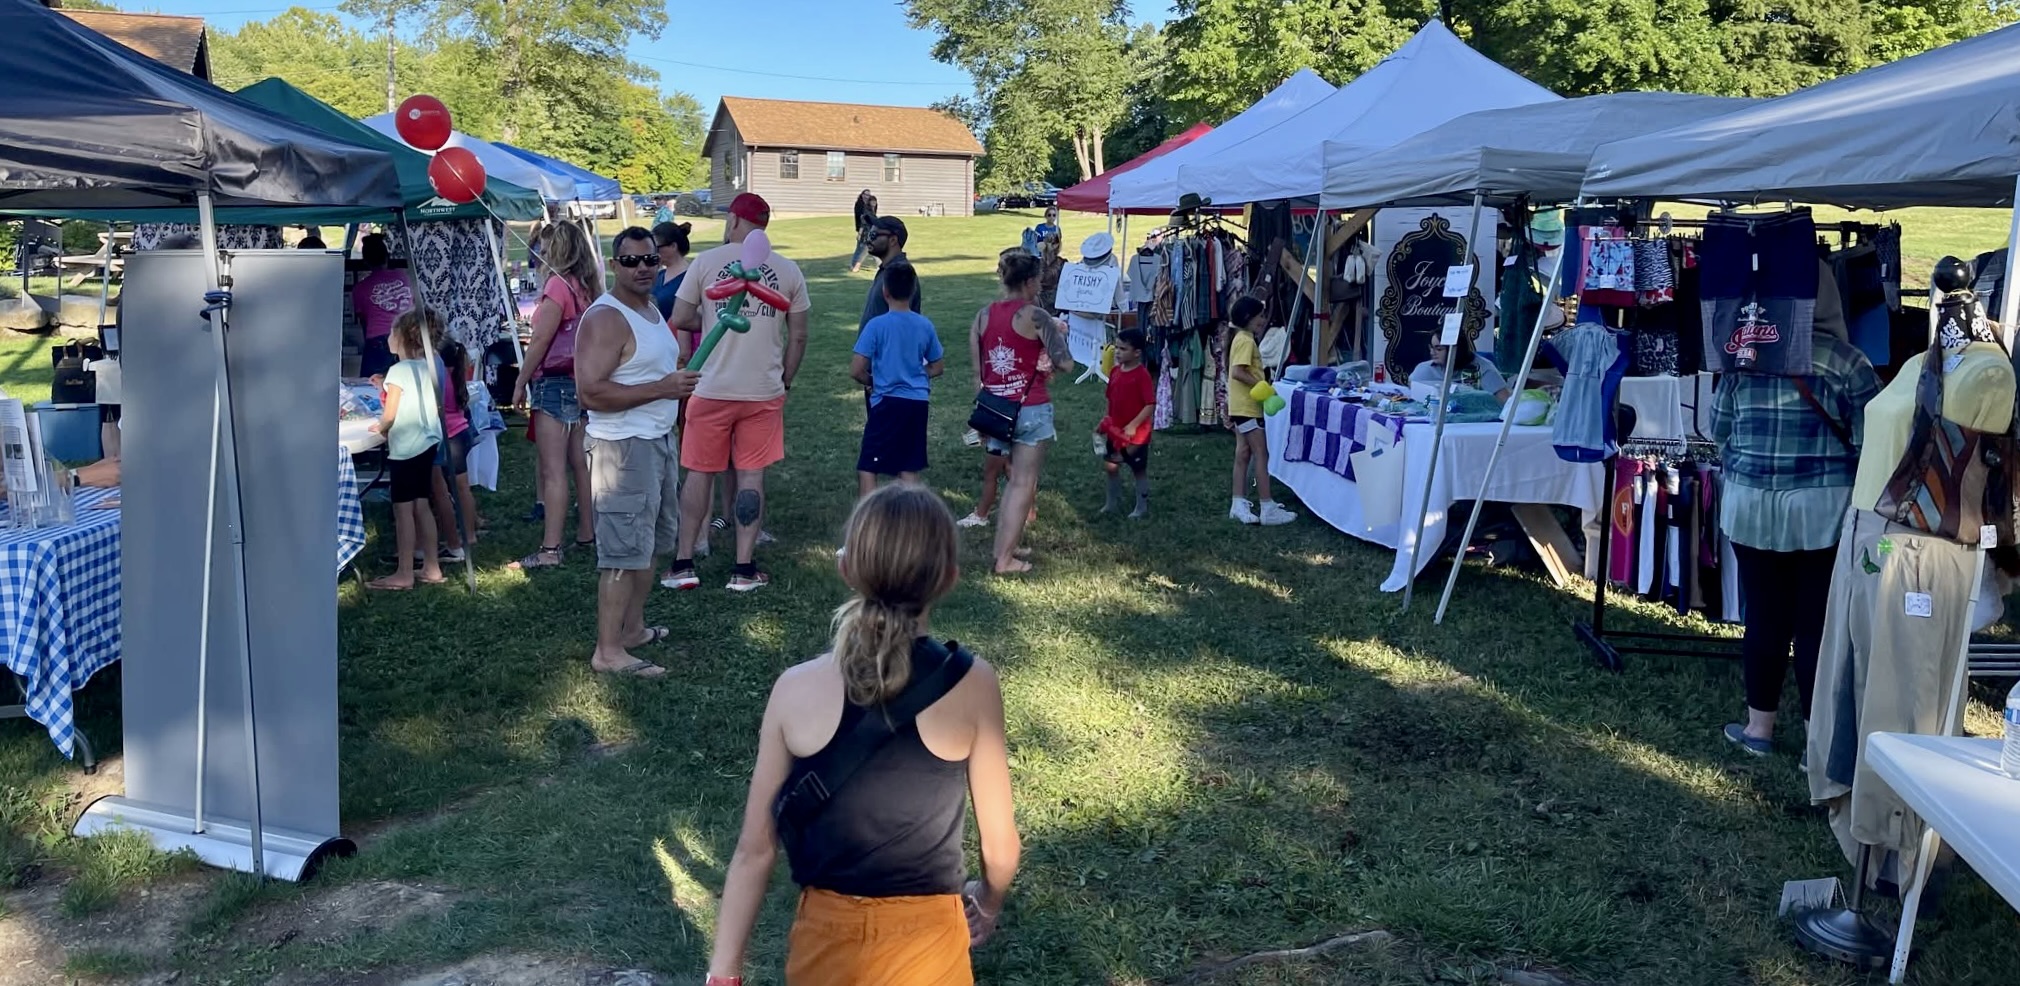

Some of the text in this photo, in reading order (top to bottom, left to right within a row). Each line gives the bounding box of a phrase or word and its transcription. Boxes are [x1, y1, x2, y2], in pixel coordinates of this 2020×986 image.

[1073, 274, 1103, 288] TRISHY
[1405, 261, 1446, 297] Joyc
[1401, 295, 1458, 324] Boutiqu
